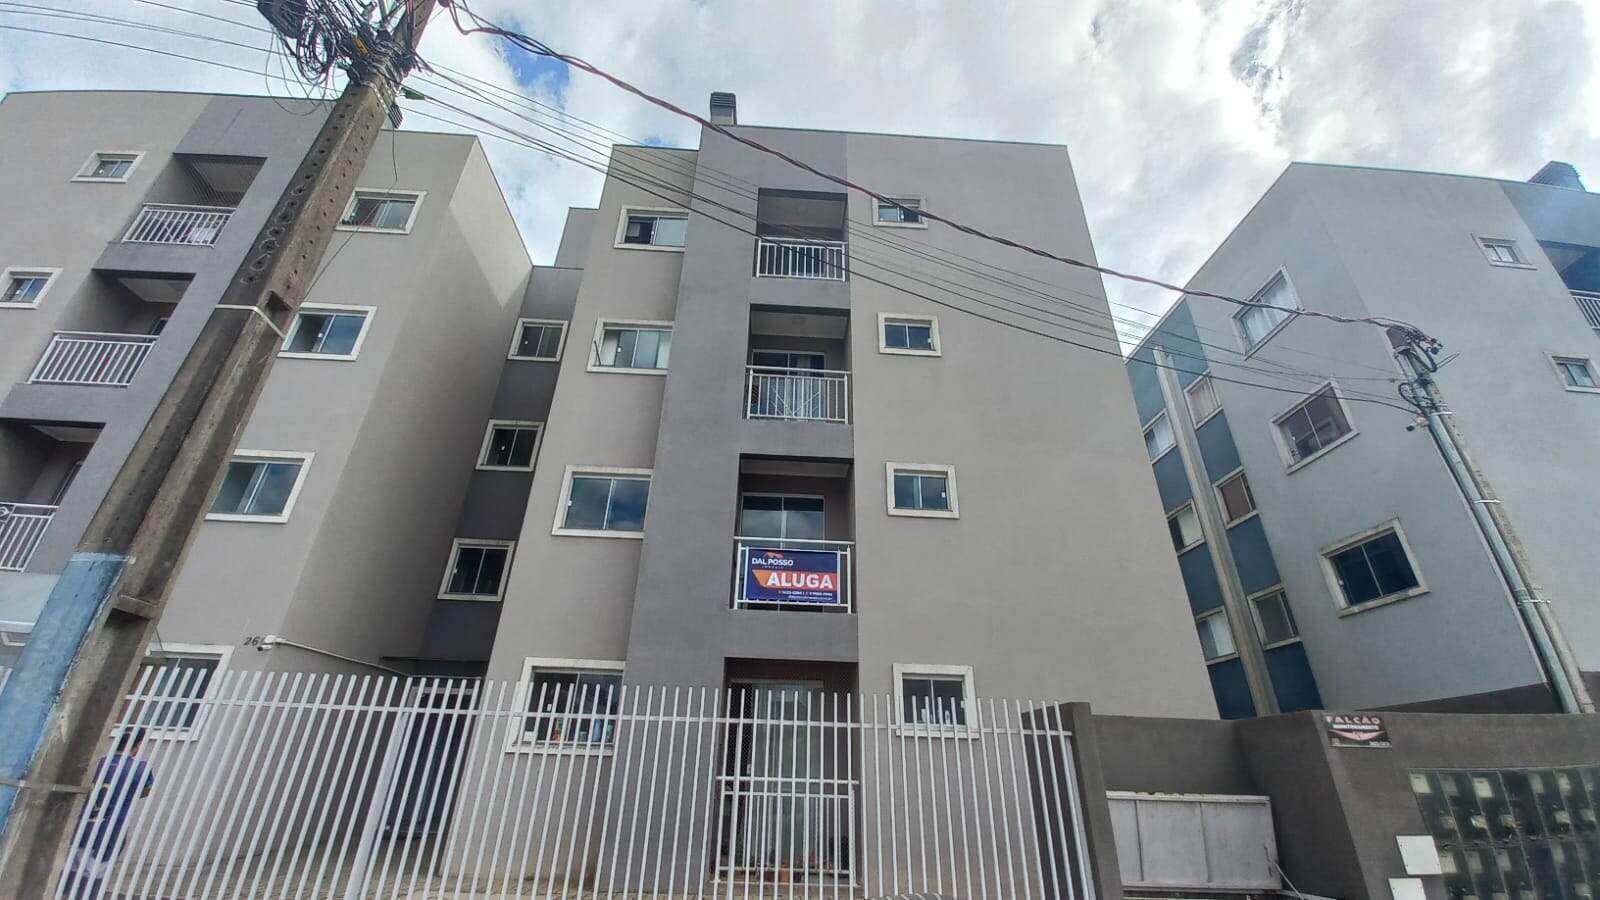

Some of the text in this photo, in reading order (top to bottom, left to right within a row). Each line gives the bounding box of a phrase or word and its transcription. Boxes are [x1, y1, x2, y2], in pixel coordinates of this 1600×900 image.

[752, 557, 794, 566] DAL POSSO
[767, 572, 833, 589] ALUGA
